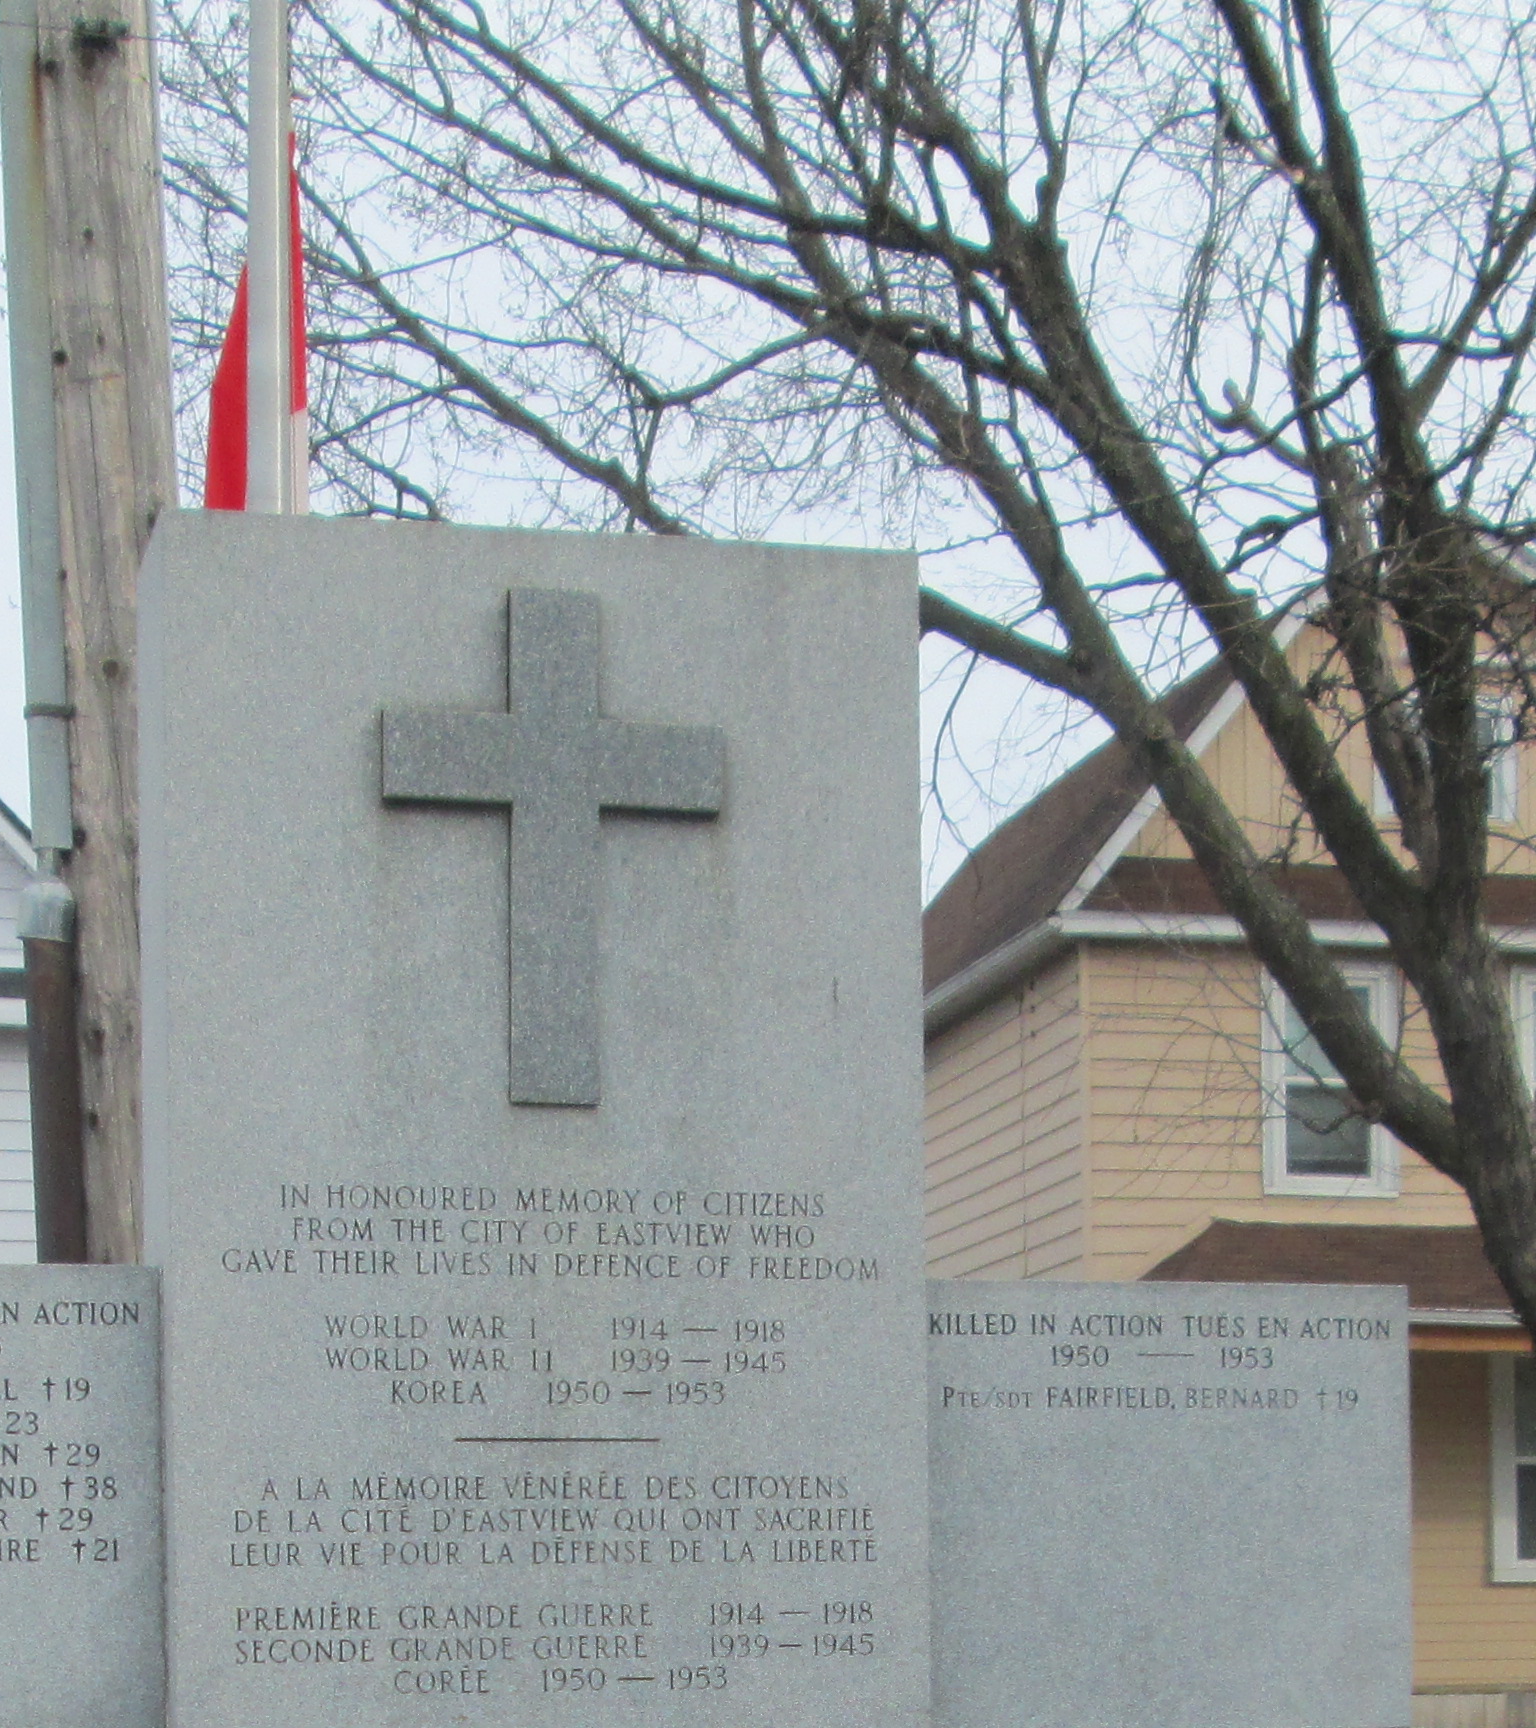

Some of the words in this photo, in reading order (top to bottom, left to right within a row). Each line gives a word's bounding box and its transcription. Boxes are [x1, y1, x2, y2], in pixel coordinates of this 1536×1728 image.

[279, 1184, 309, 1209] IN
[326, 1185, 496, 1212] HONOURED
[516, 1189, 638, 1214] MEMORY
[652, 1190, 688, 1216] OF
[703, 1192, 826, 1218] CITIZENS
[292, 1217, 374, 1242] FROM
[391, 1218, 444, 1243] THE
[462, 1220, 525, 1244] CITY
[545, 1221, 579, 1246] OF
[597, 1222, 731, 1247] EASTVIEW
[749, 1225, 814, 1248] WHO
[221, 1249, 297, 1274] GAVE
[314, 1250, 399, 1274] THEIR
[416, 1251, 490, 1276] LIVES
[508, 1252, 537, 1277] IN
[554, 1252, 680, 1278] DEFENCE
[697, 1256, 731, 1279] OF
[749, 1256, 879, 1281] FREEDOM
[34, 1302, 141, 1325] ACTION
[928, 1314, 1016, 1336] KILLED
[1031, 1315, 1056, 1335] IN
[1071, 1315, 1163, 1337] ACTION
[1182, 1315, 1245, 1338] TUÉS
[1258, 1317, 1288, 1338] EN
[1300, 1318, 1392, 1339] ACTION
[325, 1316, 428, 1339] WORLD
[448, 1316, 505, 1339] WAR
[611, 1318, 667, 1340] 1914
[733, 1319, 785, 1342] 1918
[325, 1348, 429, 1372] WORLD
[448, 1348, 505, 1372] WAR
[611, 1351, 668, 1373] 1939
[724, 1351, 786, 1374] 1945
[1051, 1345, 1110, 1367] 1950
[1220, 1348, 1274, 1369] 1953
[391, 1381, 487, 1405] KOREA
[547, 1382, 611, 1404] 1950
[665, 1382, 725, 1405] 1953
[1186, 1389, 1298, 1409] BERNARD
[296, 1478, 330, 1500] LA
[352, 1472, 487, 1501] MÉMOIRE
[503, 1471, 628, 1500] VÉNÉRÉE
[645, 1477, 697, 1500] DES
[712, 1476, 849, 1500] CITOYENS
[234, 1510, 271, 1533] DE
[288, 1510, 322, 1532] LA
[341, 1507, 413, 1532] CITÉ
[431, 1508, 598, 1532] D'EASTVIEW
[614, 1508, 666, 1533] QUI
[682, 1508, 741, 1532] ONT
[755, 1503, 874, 1531] SACRIFIÉ
[230, 1543, 301, 1567] LEUR
[319, 1543, 363, 1566] VIE
[383, 1542, 462, 1566] POUR
[480, 1542, 514, 1565] LA
[532, 1537, 652, 1565] DÉFENSE
[670, 1540, 704, 1564] DE
[722, 1540, 755, 1562] LA
[771, 1536, 877, 1564] LIBERTÉ
[236, 1602, 381, 1631] PREMIÈRE
[398, 1605, 522, 1629] GRANDE
[538, 1604, 653, 1628] GUERRE
[709, 1603, 763, 1625] 1914
[822, 1602, 873, 1624] 1918
[236, 1640, 374, 1664] SECONDE
[391, 1639, 514, 1662] GRANDE
[533, 1636, 648, 1661] GUERRE
[709, 1634, 769, 1657] 1939
[812, 1634, 874, 1657] 1945
[393, 1666, 490, 1694] CORÉE
[541, 1668, 606, 1692] 1950
[667, 1666, 727, 1690] 1953
